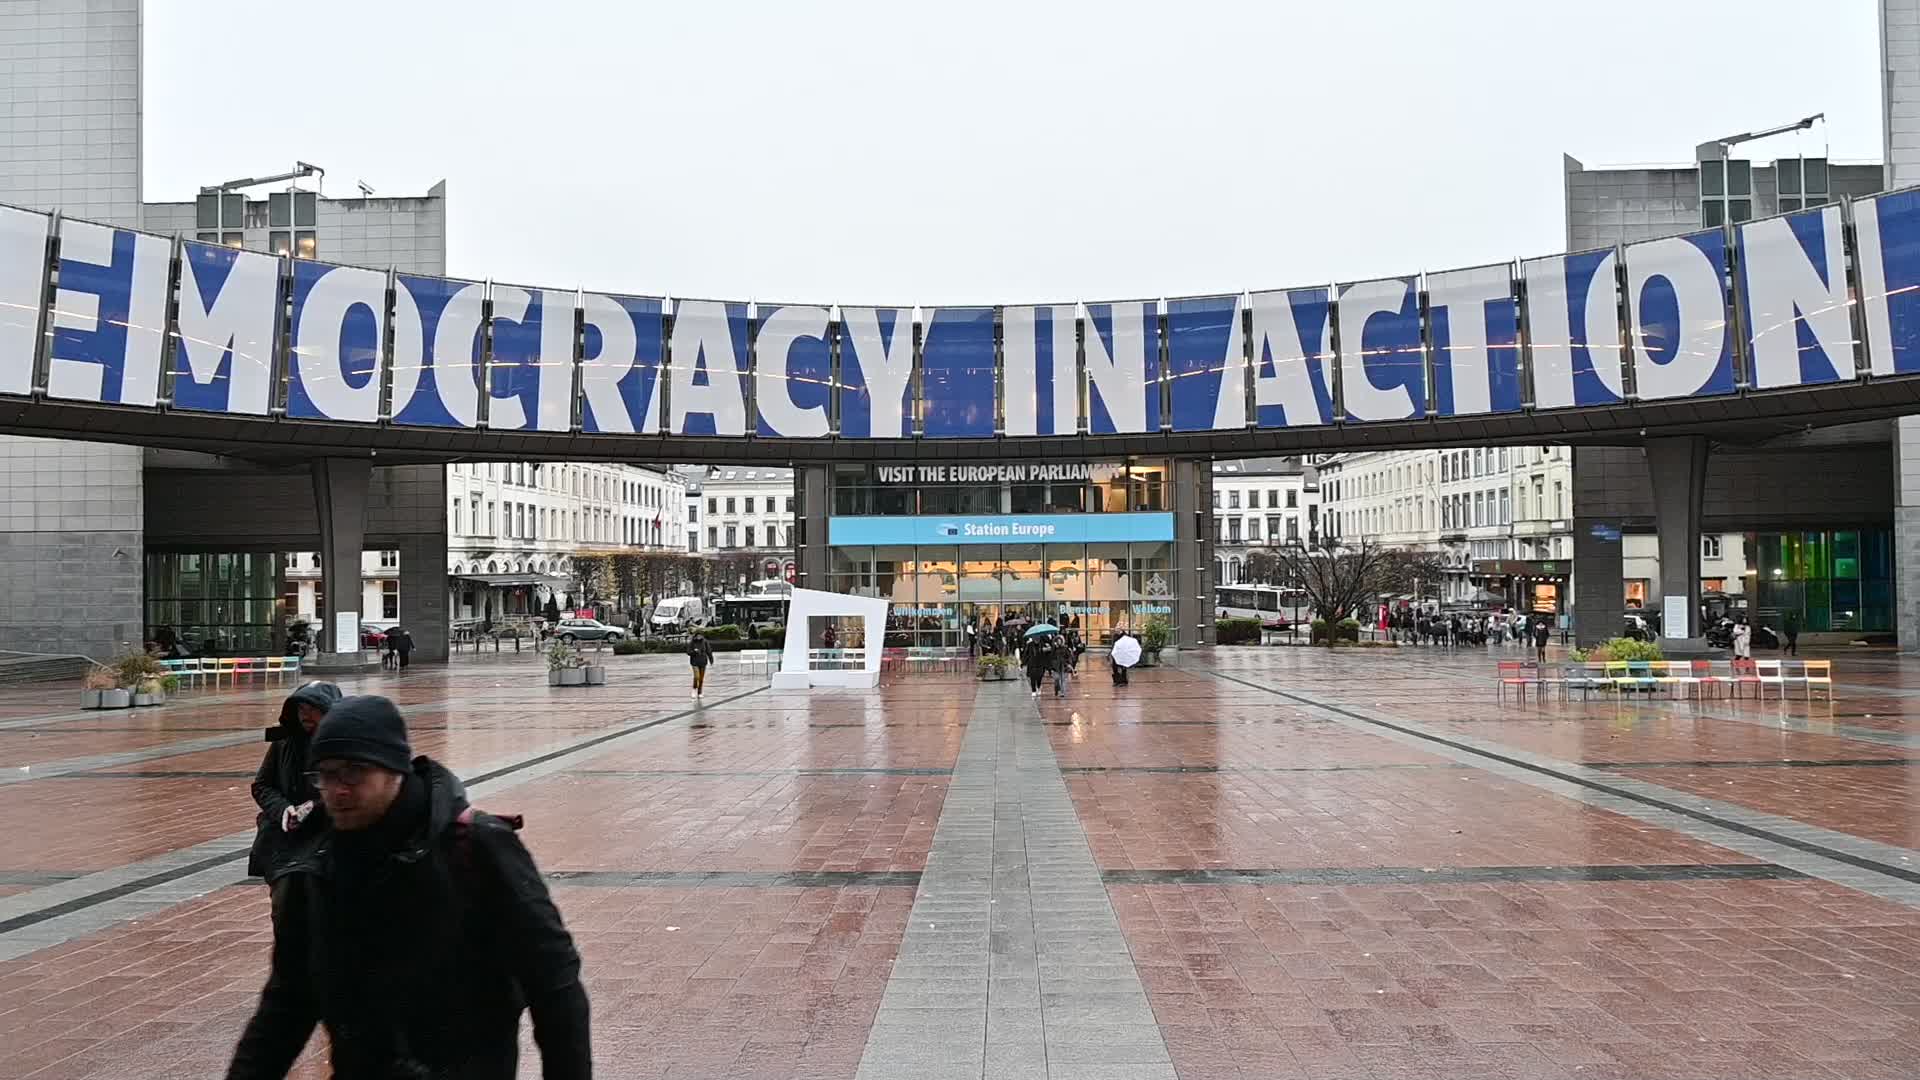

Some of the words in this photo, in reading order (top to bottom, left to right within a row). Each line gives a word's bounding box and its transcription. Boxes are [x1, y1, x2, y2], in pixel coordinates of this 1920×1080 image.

[1003, 302, 1147, 436] IN
[1211, 198, 1894, 430] ACTION
[878, 466, 915, 482] VISIT
[918, 466, 946, 482] THE
[949, 464, 1026, 482] EUROPEAN
[963, 522, 1009, 536] Station
[1011, 522, 1055, 538] Europe
[1132, 604, 1172, 615] Welkom
